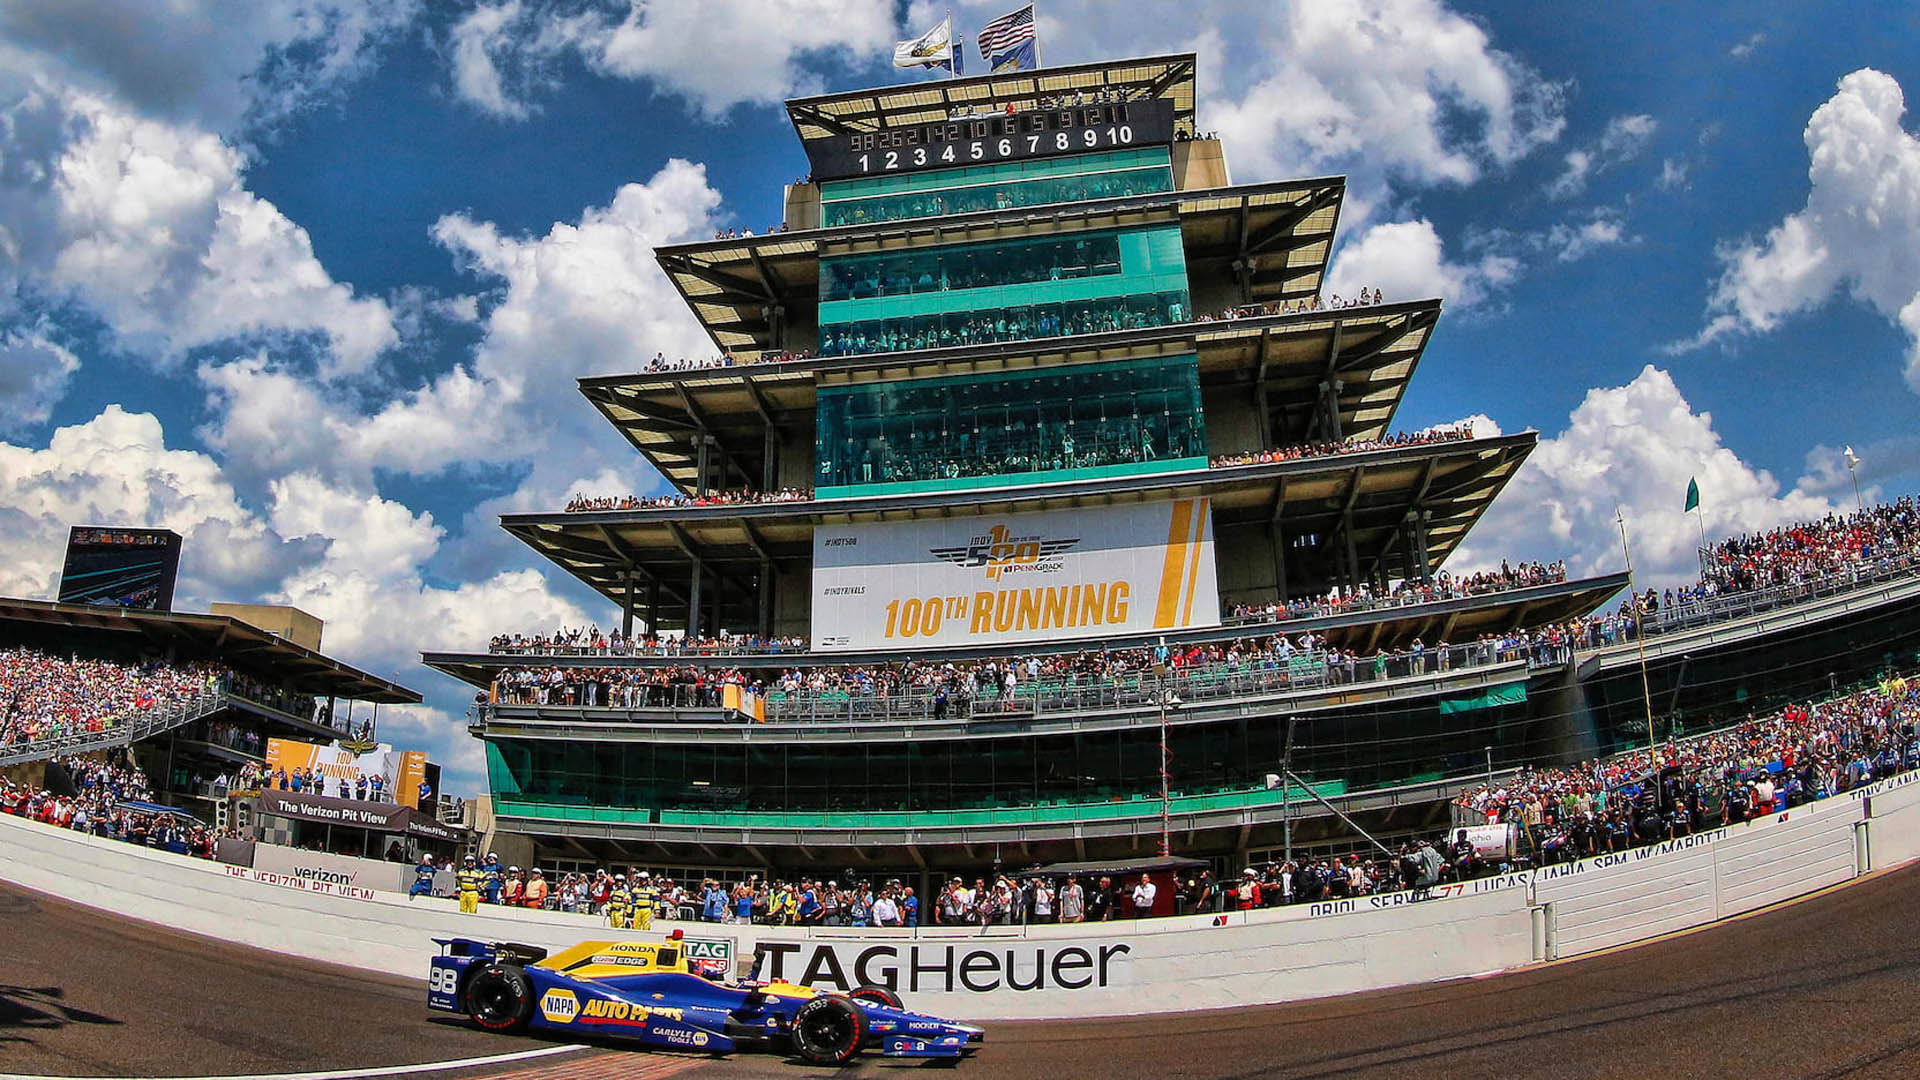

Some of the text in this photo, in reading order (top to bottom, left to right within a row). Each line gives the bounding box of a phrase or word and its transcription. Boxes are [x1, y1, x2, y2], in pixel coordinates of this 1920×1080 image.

[858, 126, 1133, 172] 1 2 3 4 5 6 7 8 9 10
[884, 581, 1130, 638] 100TH RUNNING
[278, 800, 388, 825] The Verizon Pit View
[294, 866, 350, 885] verizon
[610, 945, 656, 954] HONDA
[686, 942, 728, 959] TAG
[617, 957, 647, 966] EDGE
[429, 966, 458, 995] 98
[545, 996, 575, 1015] NAPA
[582, 999, 629, 1019] AUTO
[652, 1026, 693, 1039] CARLYLE
